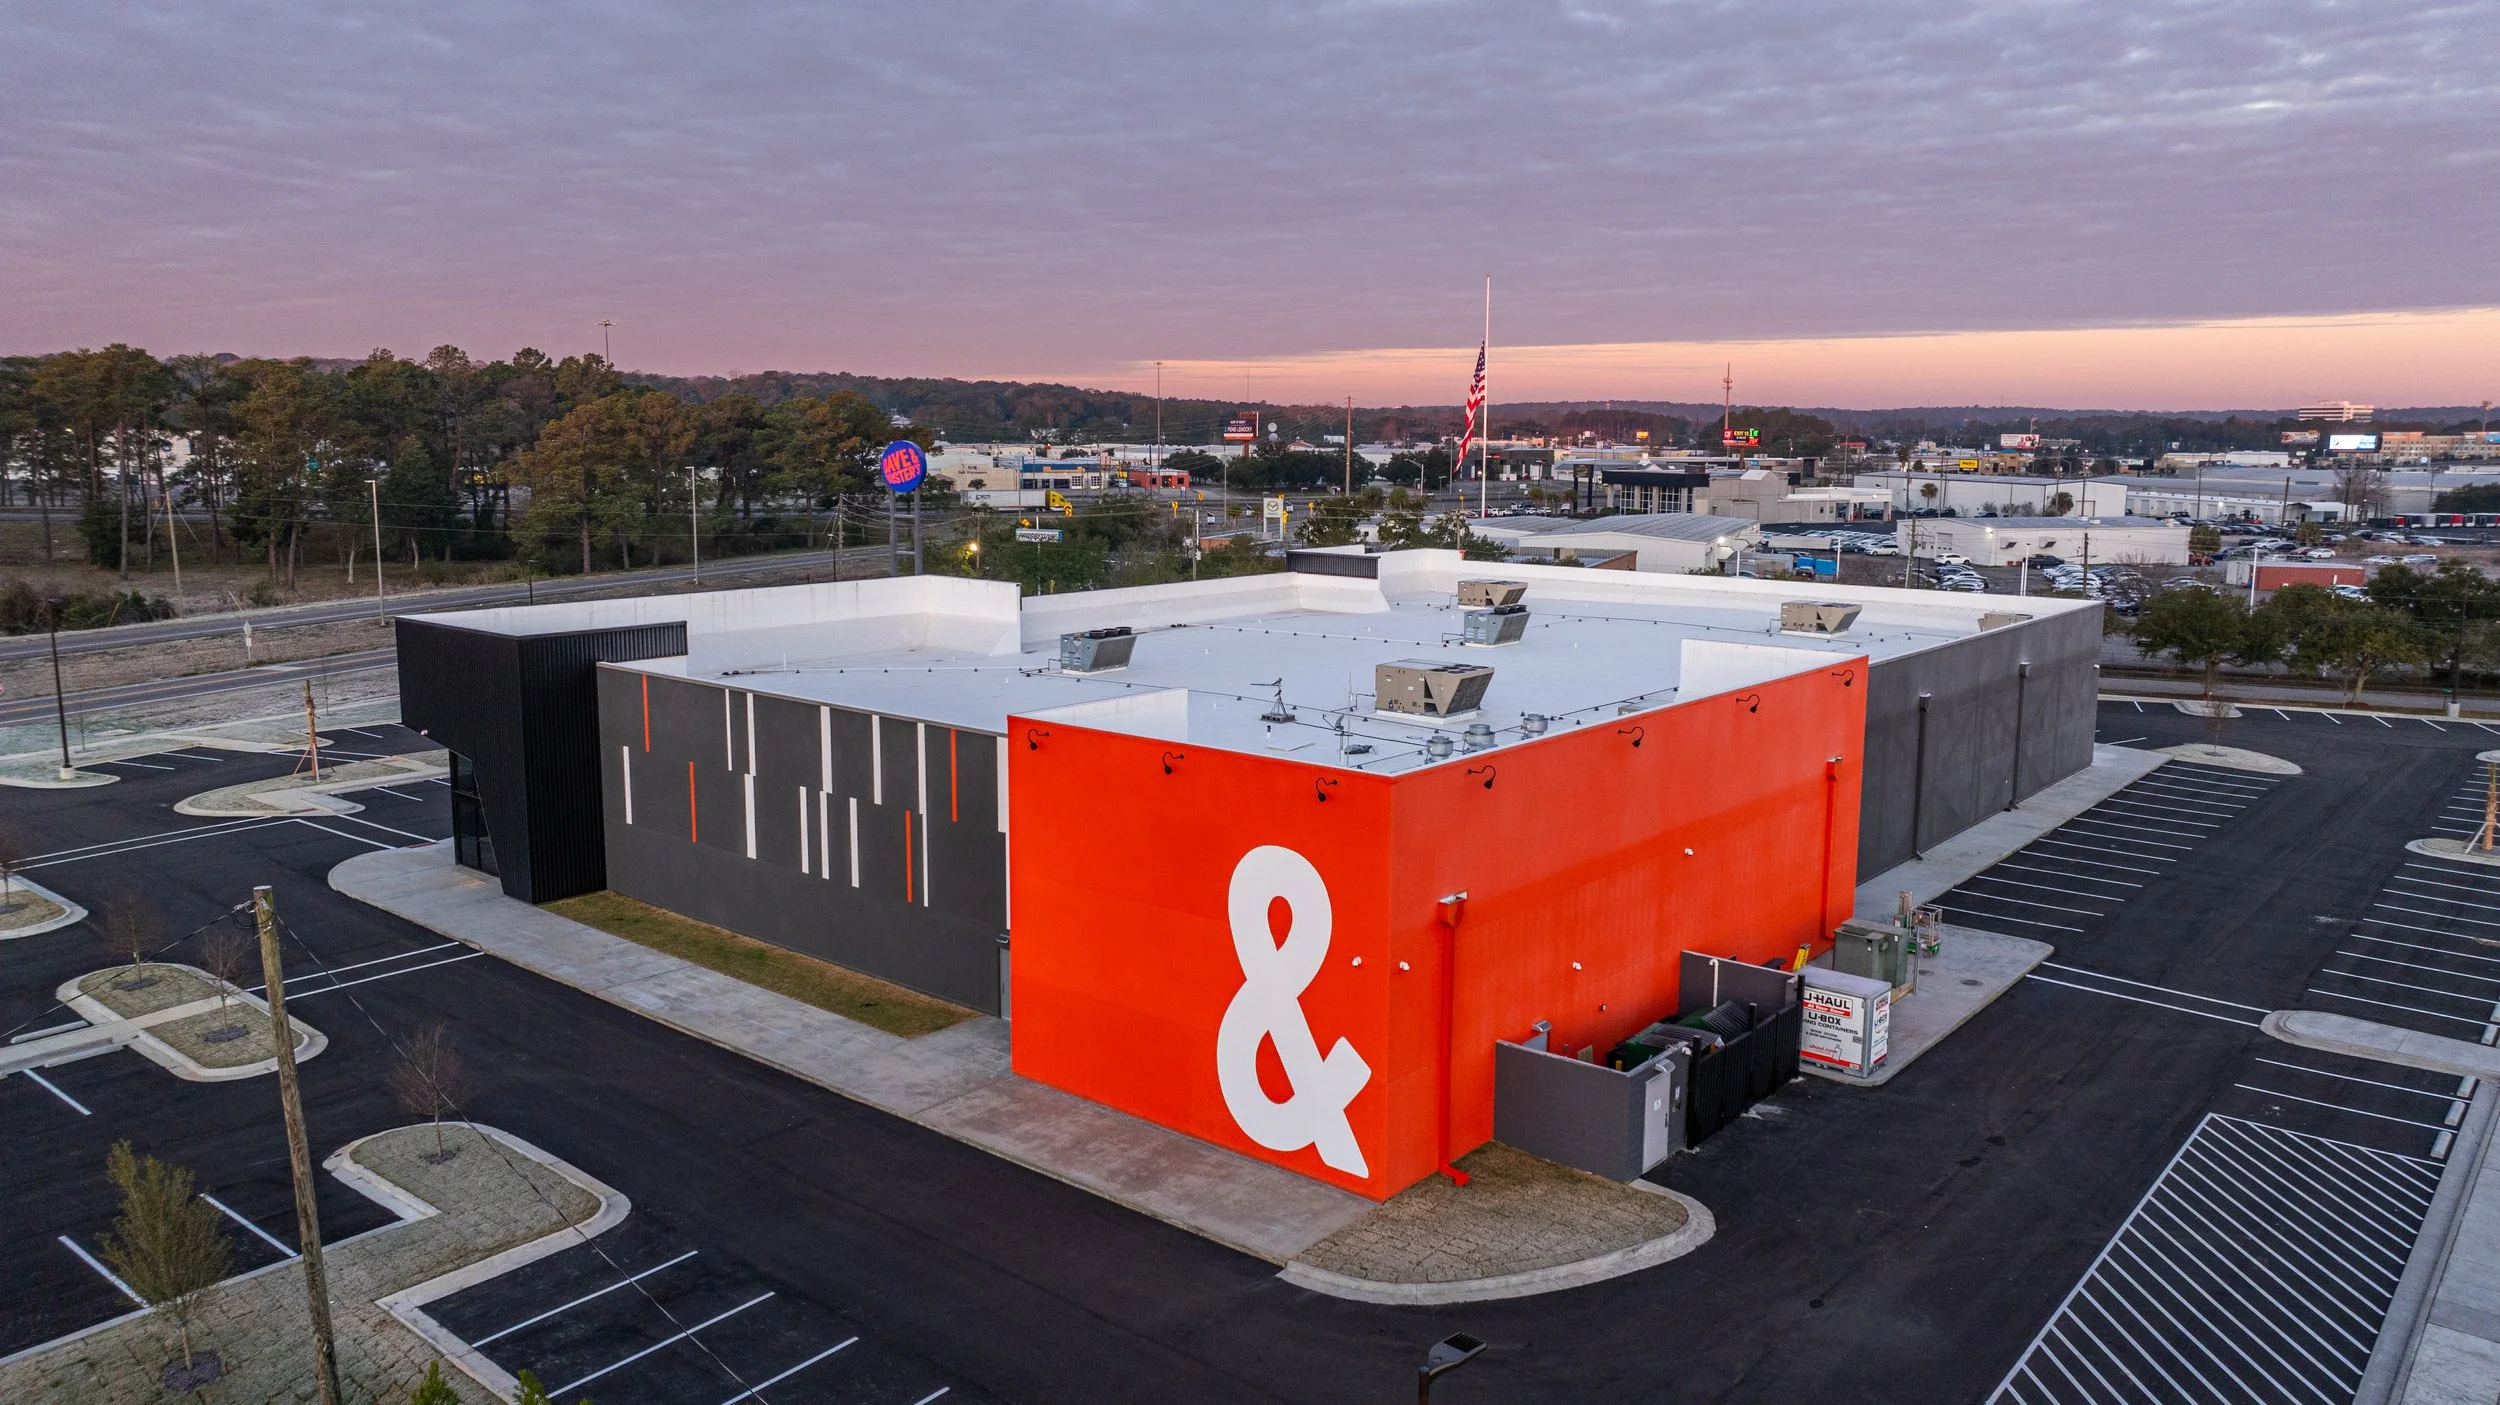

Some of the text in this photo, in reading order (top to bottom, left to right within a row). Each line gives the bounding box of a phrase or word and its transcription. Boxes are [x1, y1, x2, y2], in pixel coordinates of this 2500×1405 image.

[1216, 845, 1371, 1179] &
[1815, 1004, 1829, 1012] Your
[1830, 1008, 1846, 1016] Door
[1808, 1012, 1841, 1025] U-BOX
[1818, 1021, 1858, 1035] CONTAINERS
